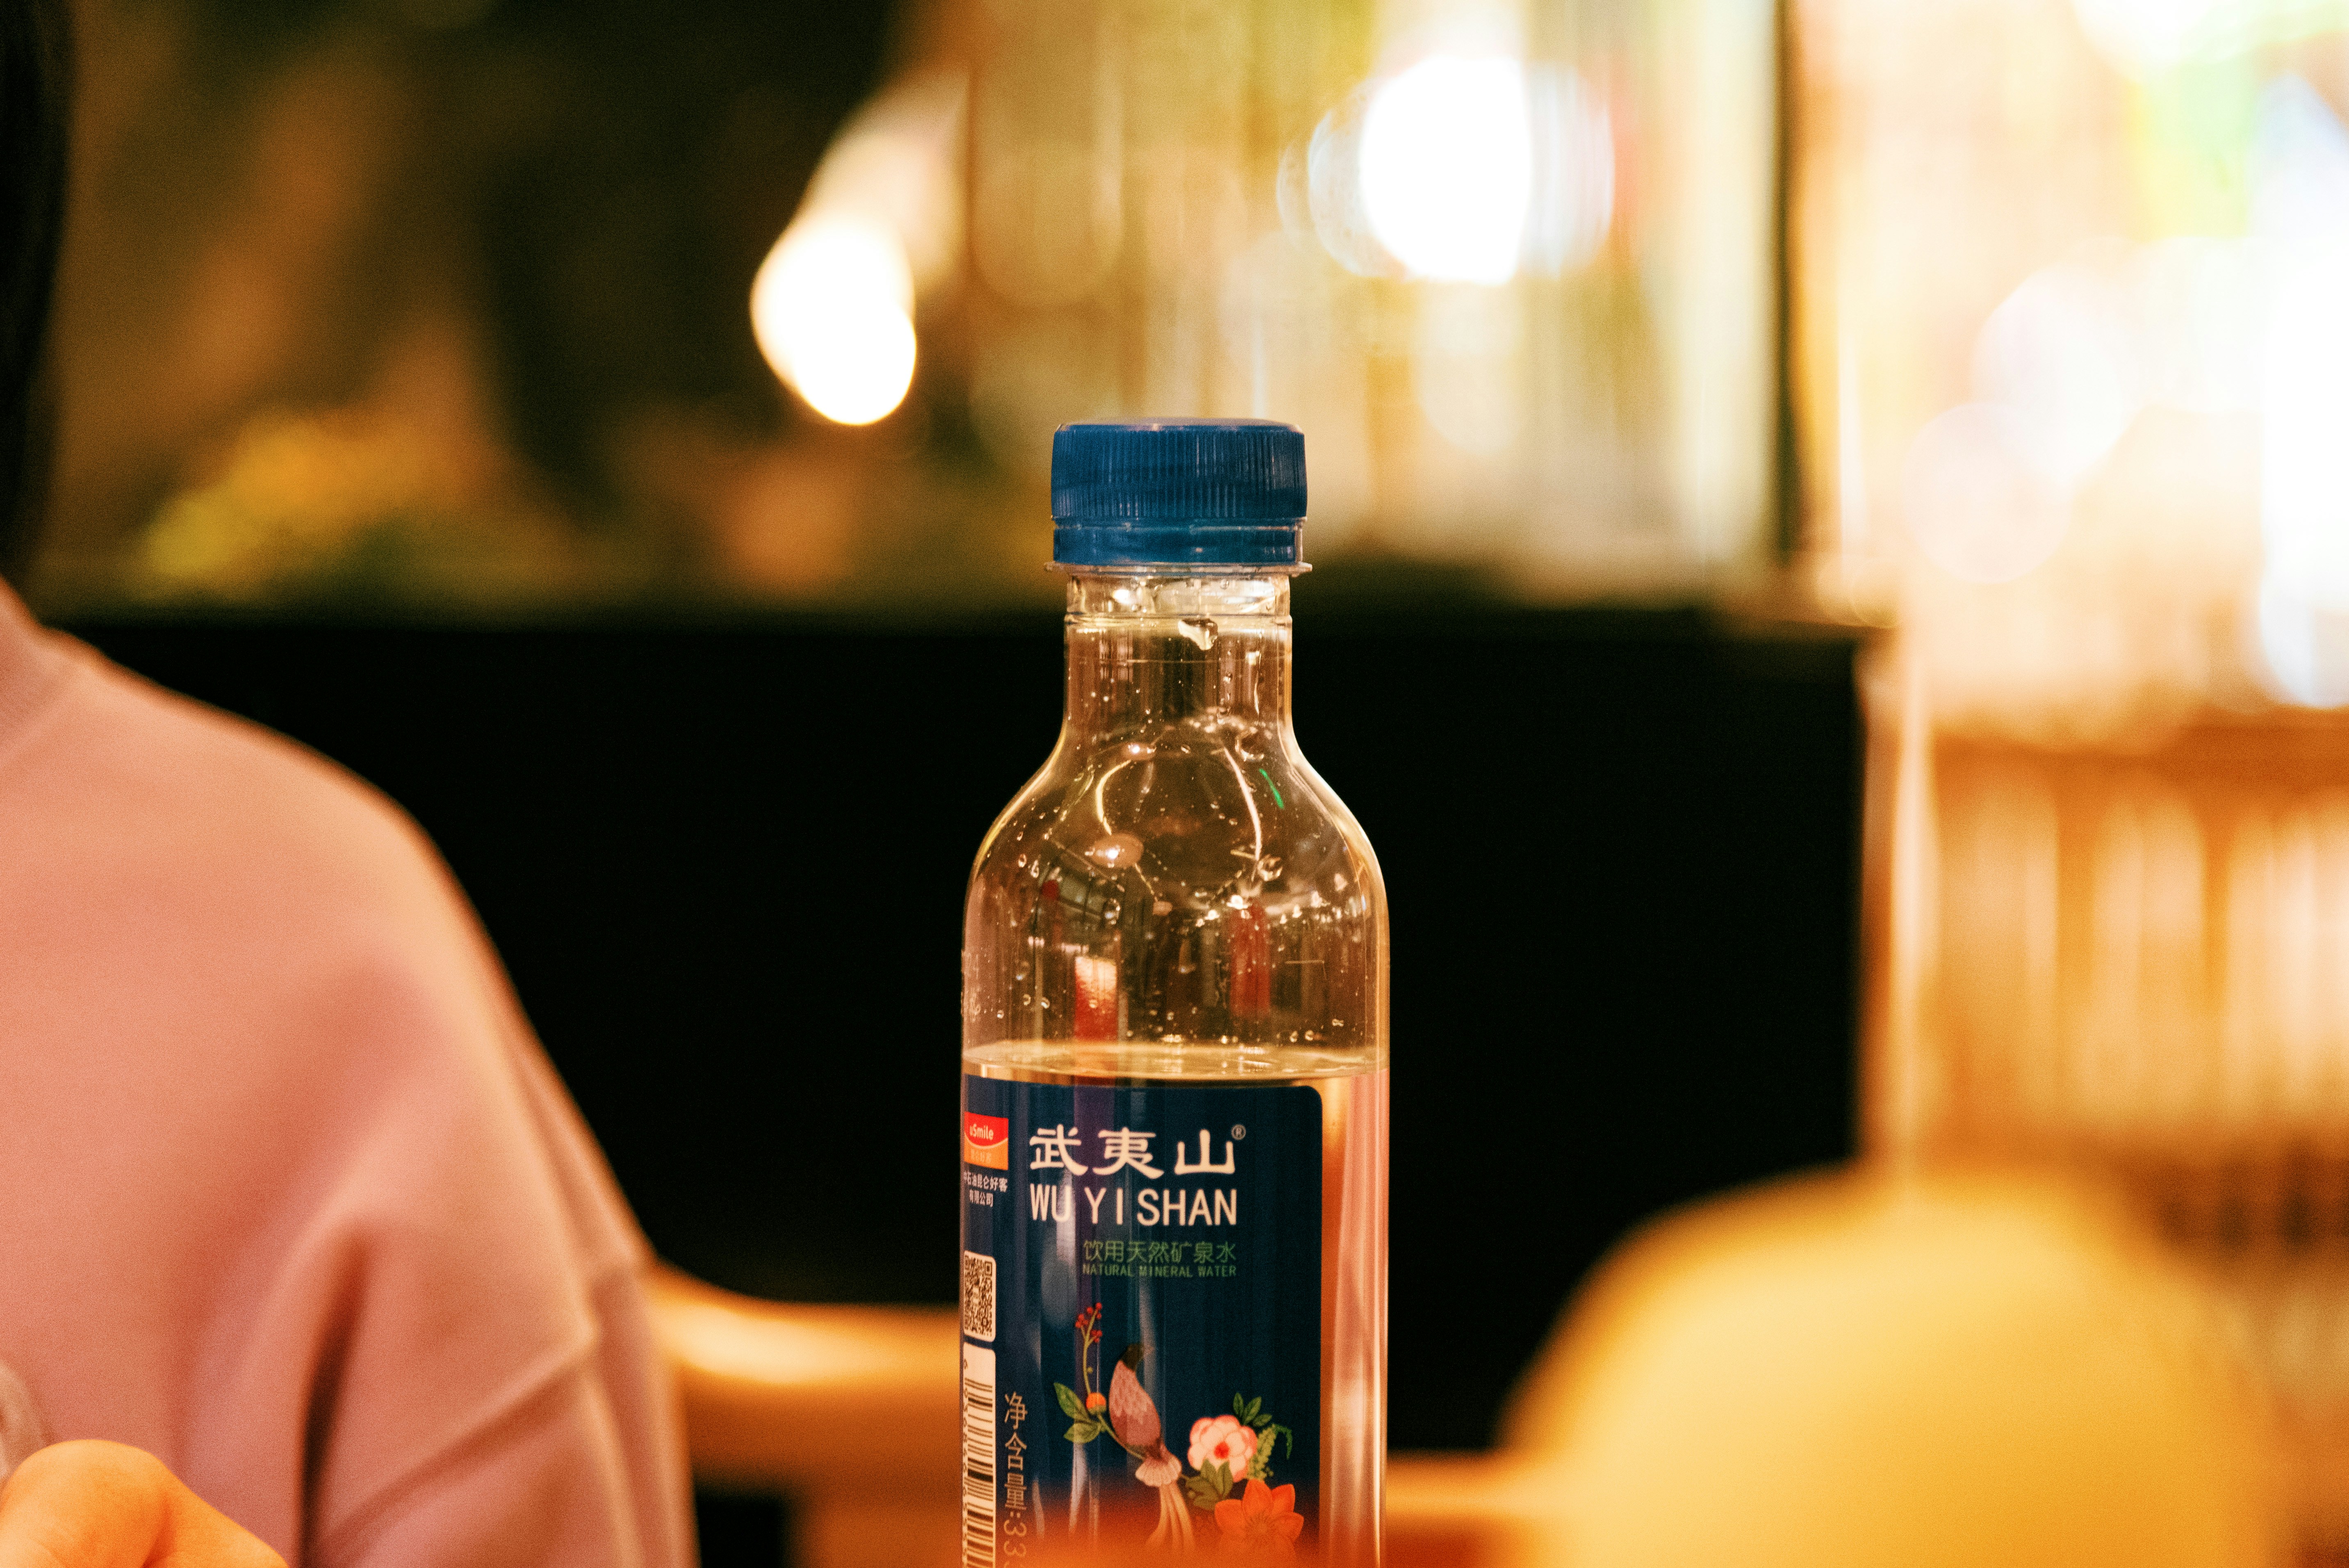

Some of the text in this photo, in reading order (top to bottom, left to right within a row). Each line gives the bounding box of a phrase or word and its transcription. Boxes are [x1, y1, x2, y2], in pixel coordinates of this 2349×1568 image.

[969, 1123, 994, 1140] uSmile
[1029, 1124, 1236, 1179] 武夷山
[1030, 1183, 1072, 1222] WU
[1137, 1188, 1237, 1226] SHAN
[1083, 1240, 1237, 1264] 饮用天然矿泉水
[1082, 1263, 1237, 1278] NATURAL MINERAL WATER
